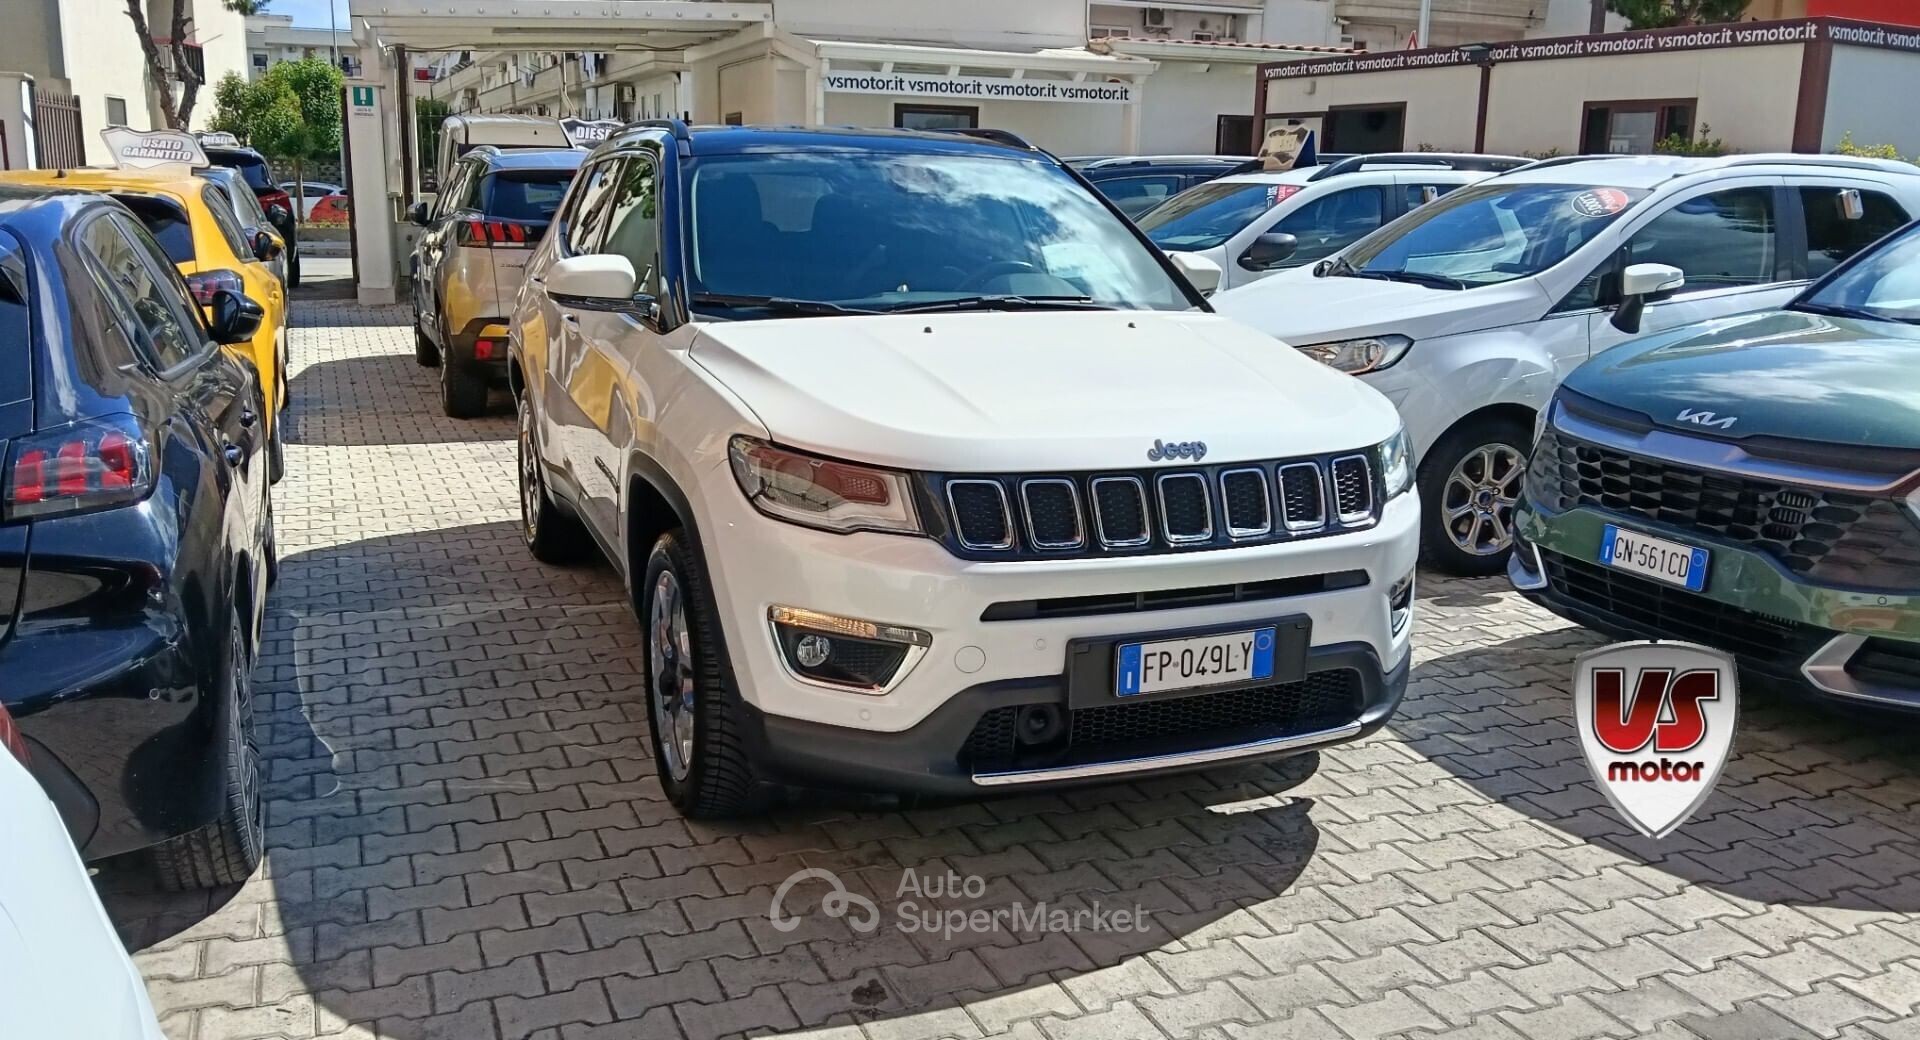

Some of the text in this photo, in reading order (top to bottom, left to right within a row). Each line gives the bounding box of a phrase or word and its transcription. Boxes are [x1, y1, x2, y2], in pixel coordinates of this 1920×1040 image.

[1828, 25, 1886, 45] vsmotor.it
[1265, 63, 1307, 78] vsmotor.it
[1309, 58, 1354, 74] vsmotor.it
[1356, 54, 1404, 70] vsmotor.it
[1407, 50, 1459, 66] vsmotor.it
[1521, 40, 1583, 57] vsmotor.it
[1587, 34, 1655, 53] vsmotor.it
[1658, 28, 1732, 48] vsmotor.it
[1735, 22, 1818, 43] vsmotor.it
[827, 76, 1129, 101] vsmotor.it vsmotor.it vsmotor.it vsmotor.it
[122, 147, 191, 160] GARANTITO
[142, 138, 182, 150] USATO
[1147, 439, 1207, 462] Jeep
